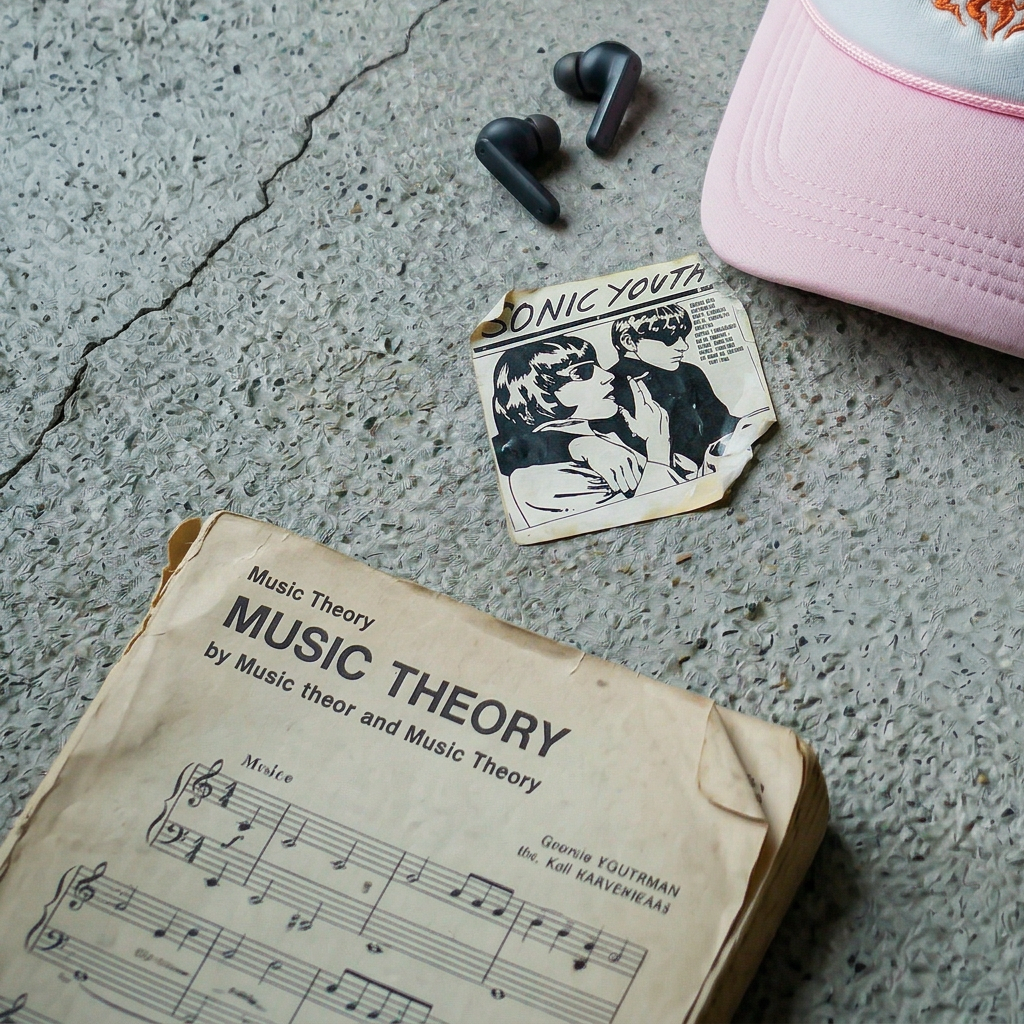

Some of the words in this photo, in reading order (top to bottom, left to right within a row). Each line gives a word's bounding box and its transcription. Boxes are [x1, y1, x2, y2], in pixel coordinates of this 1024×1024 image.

[607, 262, 706, 308] YOUTH
[247, 565, 304, 601] Music
[310, 590, 376, 632] Theory
[203, 640, 232, 666] by
[234, 653, 295, 692] Music
[300, 682, 357, 717] theor
[360, 711, 402, 736] and
[403, 724, 465, 762] Music
[472, 750, 542, 795] Theory
[222, 594, 373, 681] MUSIC
[387, 659, 572, 758] THEORY
